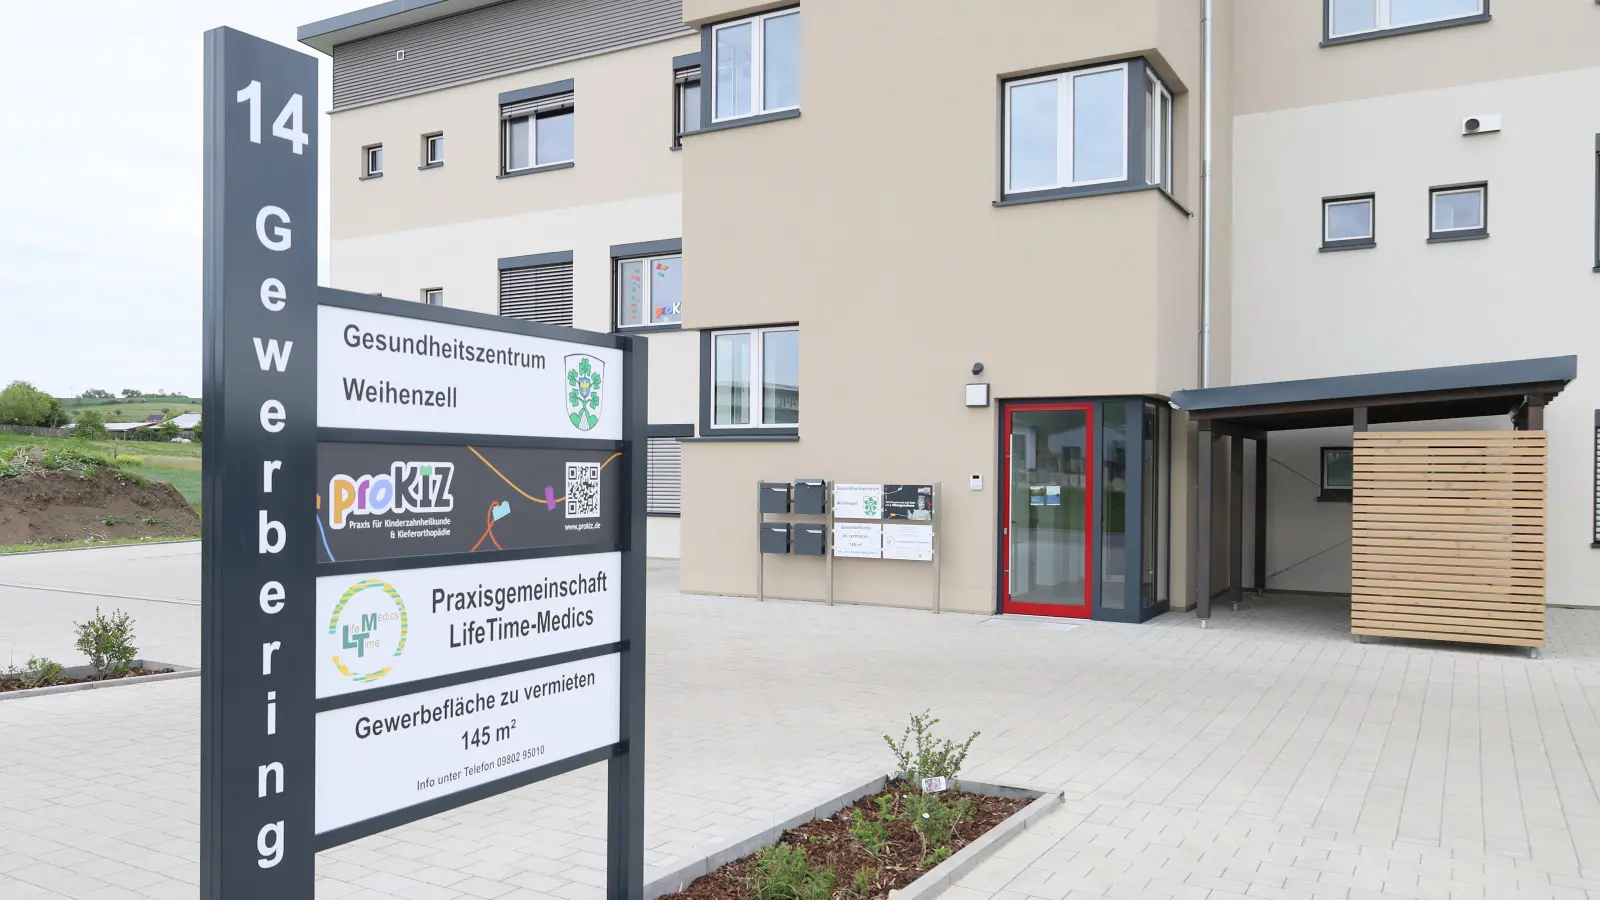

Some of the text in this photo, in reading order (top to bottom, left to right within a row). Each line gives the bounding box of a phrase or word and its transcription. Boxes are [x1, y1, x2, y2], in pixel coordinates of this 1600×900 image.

[236, 79, 309, 155] 14
[343, 323, 546, 370] Gesundheitszentrum
[342, 377, 457, 408] Weihenzell
[252, 205, 294, 869] Gewerbering
[349, 517, 451, 529] Praxis für Kinderzahnheilkunde
[397, 528, 451, 538] Kieferorthopädie
[564, 522, 601, 531] www.prokiz.de
[432, 571, 607, 613] Praxisgemeinschaft
[343, 624, 360, 649] Life
[361, 612, 399, 632] Medics
[450, 606, 594, 648] LifeTime-Medics
[352, 632, 380, 658] Time
[355, 672, 595, 739] Gewerbefläche zu vermieten
[461, 718, 517, 750] 145 m²
[417, 744, 545, 791] Info unter Telefon 09802 95010
